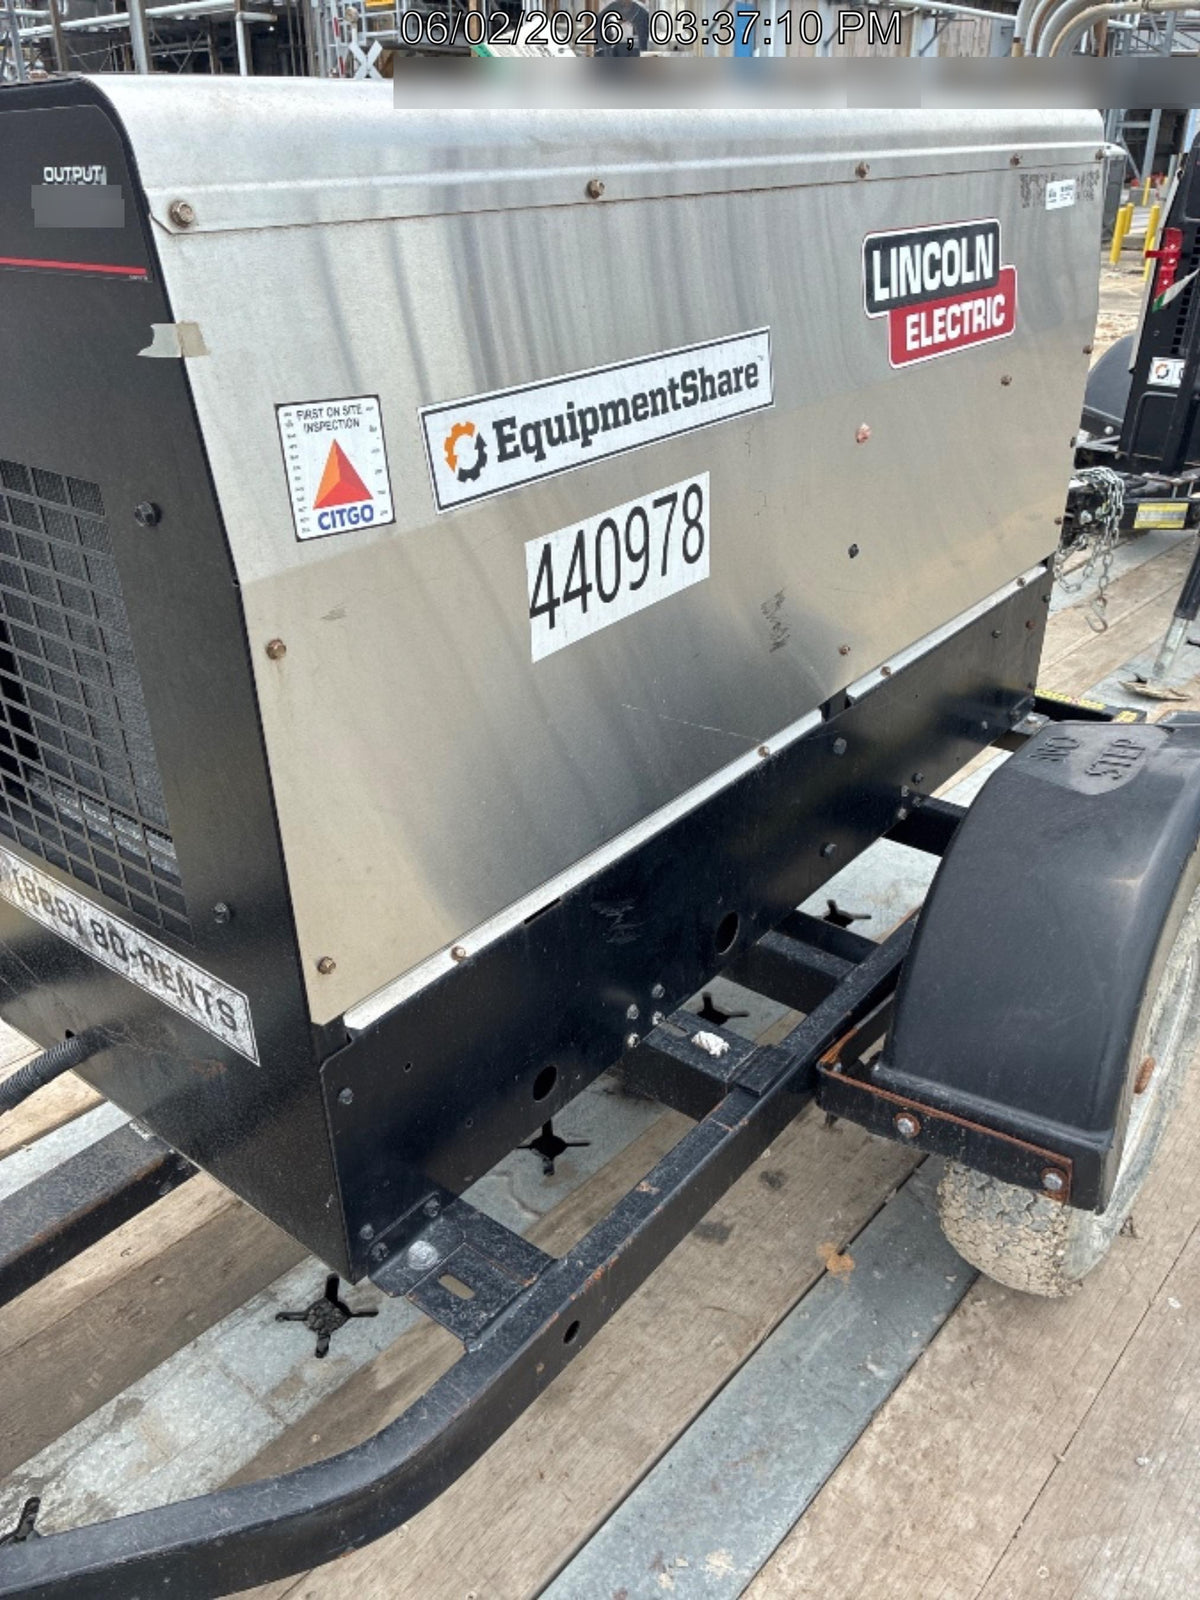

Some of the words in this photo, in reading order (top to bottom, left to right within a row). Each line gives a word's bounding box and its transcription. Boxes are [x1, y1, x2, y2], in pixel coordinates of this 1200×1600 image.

[43, 165, 102, 182] OUTPUT
[872, 233, 993, 302] LINCOLN
[906, 293, 1006, 351] ELECTRIC
[296, 408, 325, 421] FIRST
[326, 406, 341, 418] ON
[342, 403, 364, 416] SITE
[303, 417, 360, 434] INSPECTION
[492, 361, 759, 463] EquipmentShare
[317, 503, 375, 531] CITGO
[529, 483, 705, 630] 440978
[1029, 736, 1081, 762] NO
[1085, 738, 1146, 780] STEP
[89, 918, 239, 1032] 80-RENTS
